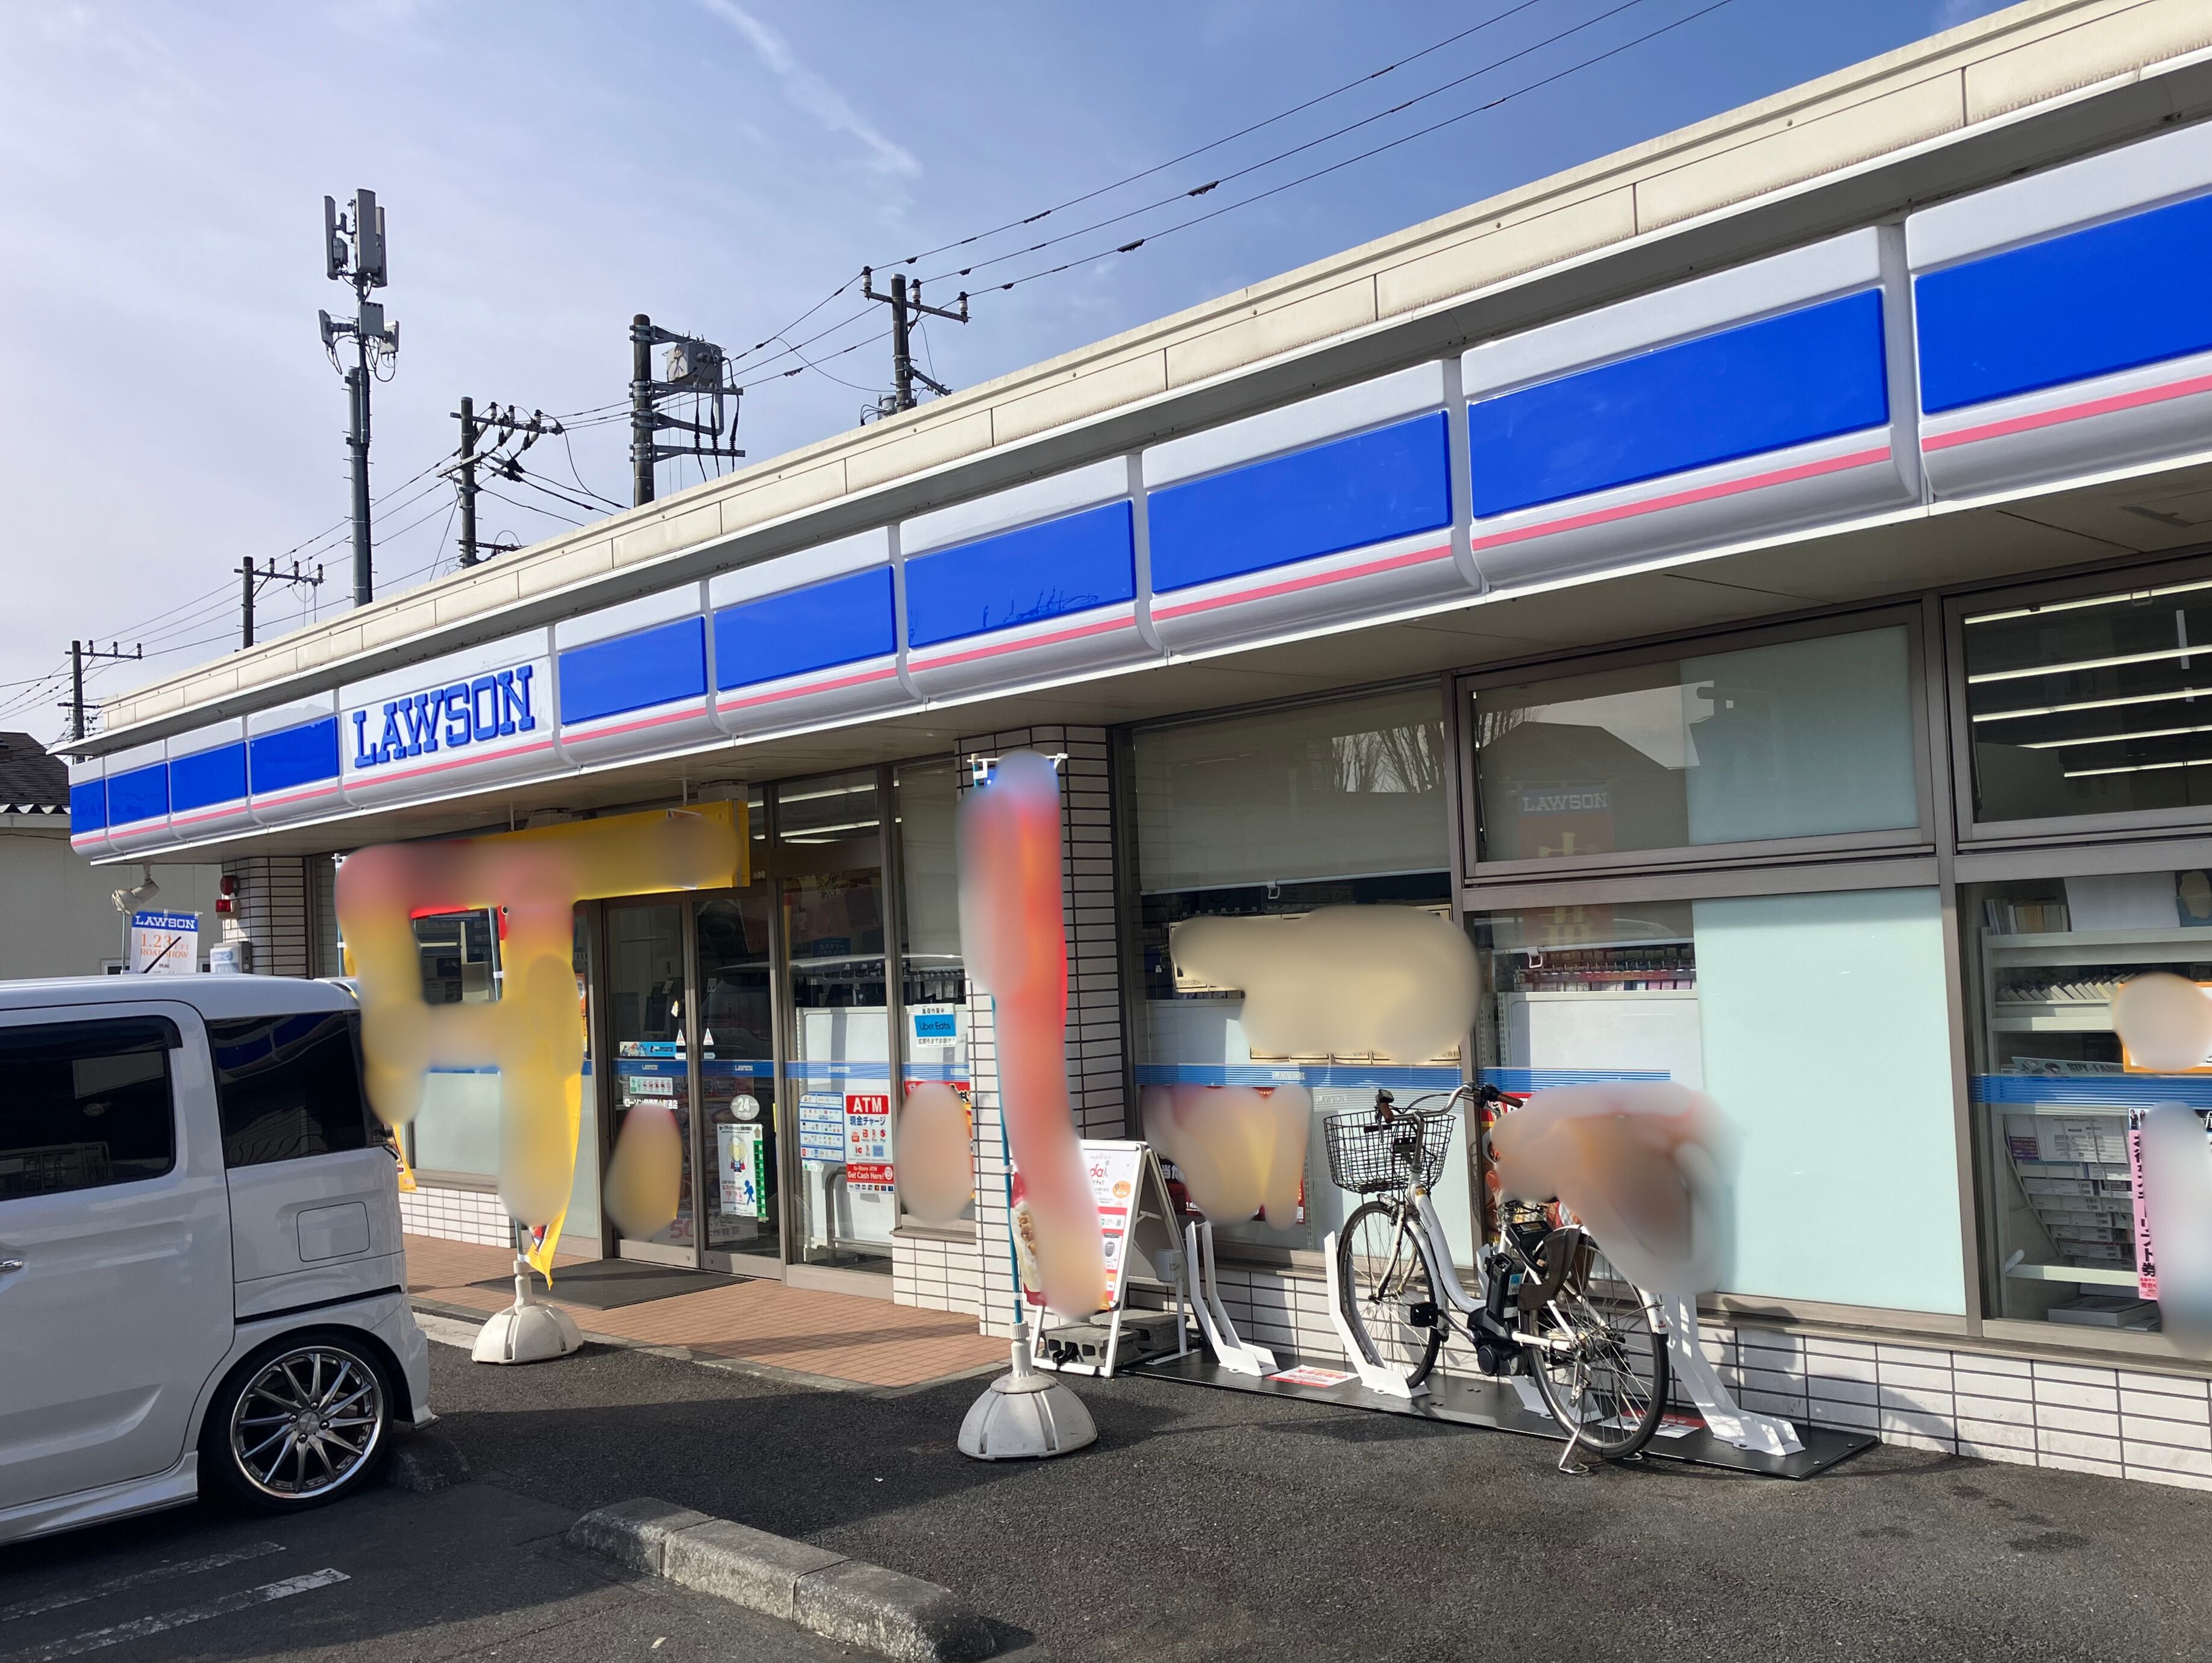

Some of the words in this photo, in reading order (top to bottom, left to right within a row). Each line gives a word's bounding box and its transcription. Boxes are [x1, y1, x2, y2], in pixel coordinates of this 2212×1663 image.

[354, 665, 535, 768] LAWSON
[1523, 792, 1608, 812] LAWSON
[135, 915, 195, 929] LAWSON
[140, 934, 172, 948] 1.23
[920, 1022, 934, 1030] Uber
[935, 1021, 951, 1030] Eats
[738, 1097, 750, 1112] 24
[853, 1097, 882, 1113] ATM
[850, 1115, 886, 1126] 現金チャージ
